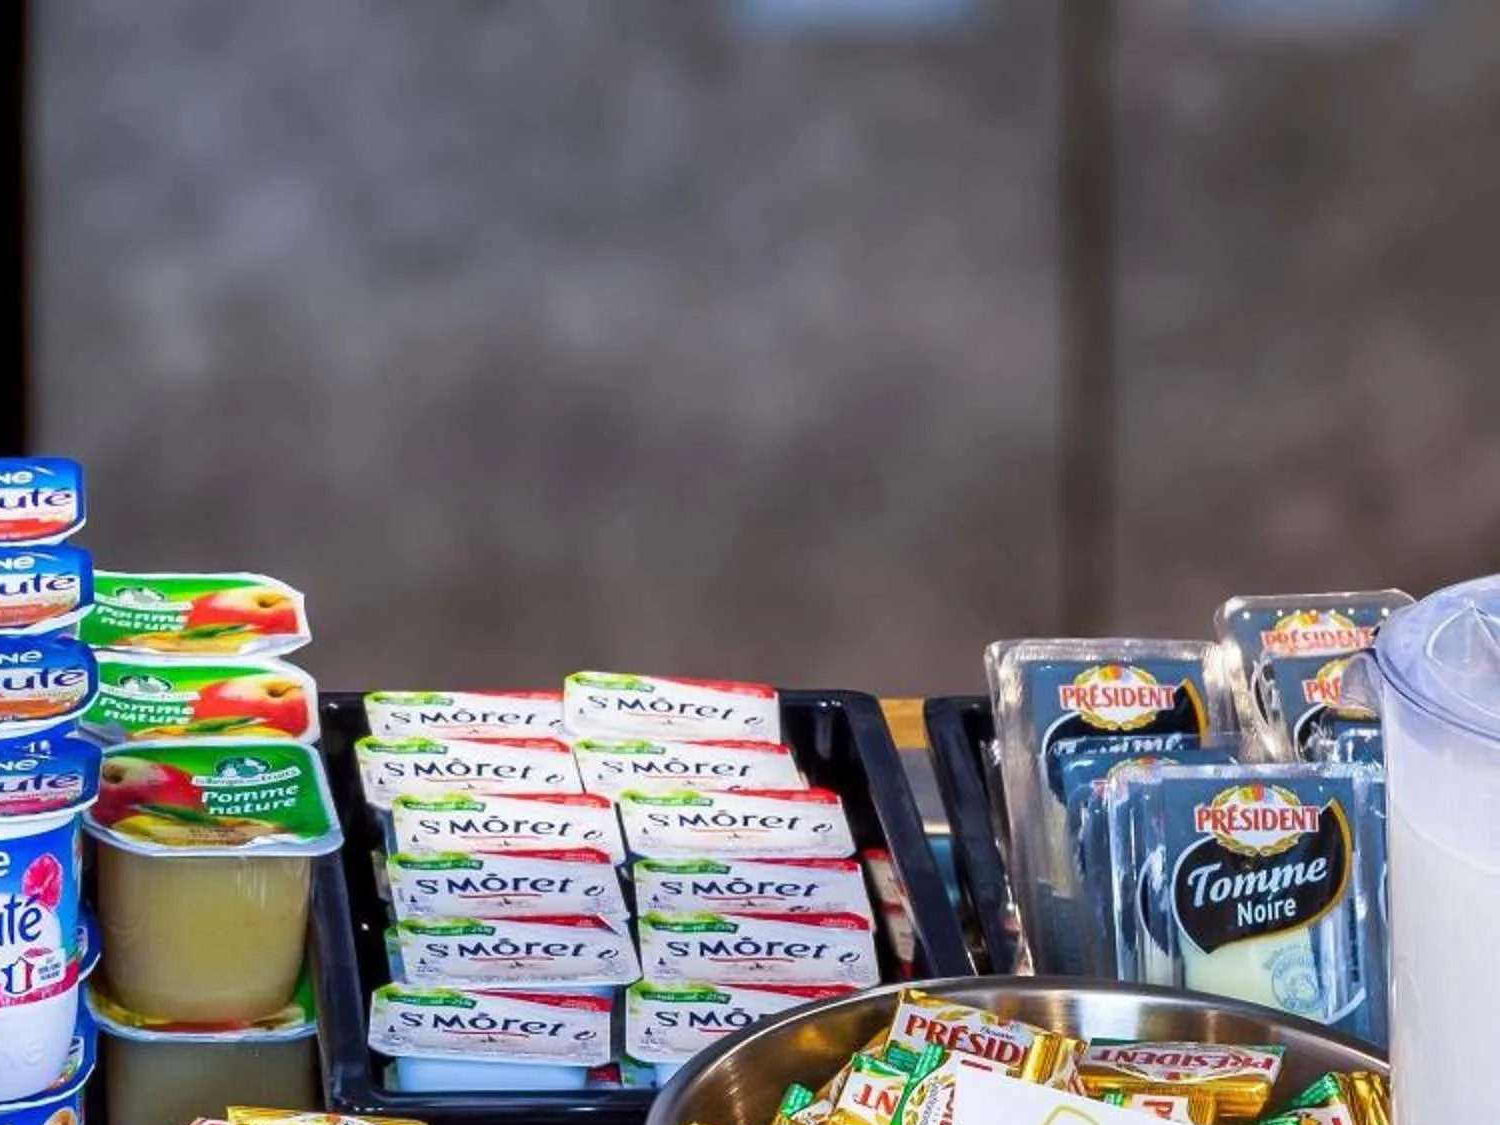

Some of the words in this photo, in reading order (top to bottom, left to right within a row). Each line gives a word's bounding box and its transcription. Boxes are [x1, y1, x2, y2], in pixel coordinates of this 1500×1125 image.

[1262, 627, 1375, 650] PRÉSIDENT
[100, 696, 194, 714] Pomme
[1060, 684, 1175, 710] PRÉSIDENT
[103, 710, 192, 724] nature
[201, 784, 300, 803] Pomme
[209, 798, 297, 814] nature
[1195, 805, 1320, 833] PRÉSIDENT
[1188, 856, 1328, 906] Tomme
[1237, 895, 1297, 927] Noire
[1099, 1049, 1275, 1071] PRÉSIDENT
